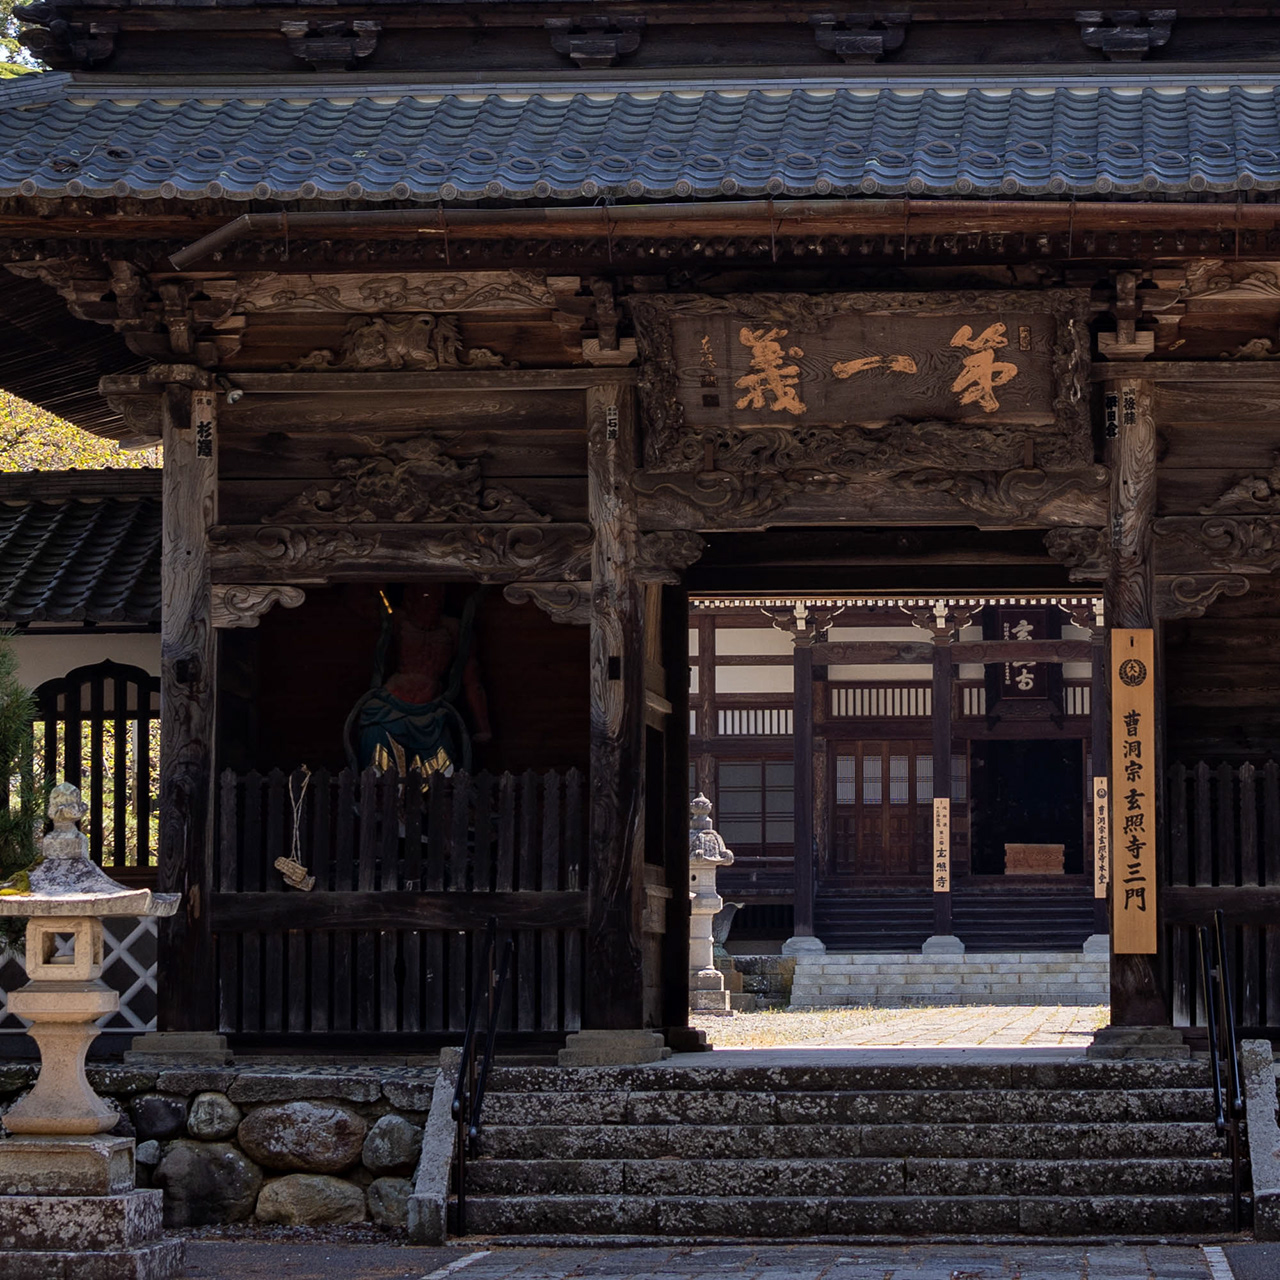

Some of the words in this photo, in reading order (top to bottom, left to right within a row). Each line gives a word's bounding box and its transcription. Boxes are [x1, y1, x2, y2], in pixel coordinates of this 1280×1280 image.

[734, 321, 1018, 416] 第一義
[1011, 619, 1037, 691] 玄寺
[1096, 805, 1107, 885] 曹洞宗玄照寺本堂
[1122, 708, 1147, 913] 曹洞宗玄照寺三門
